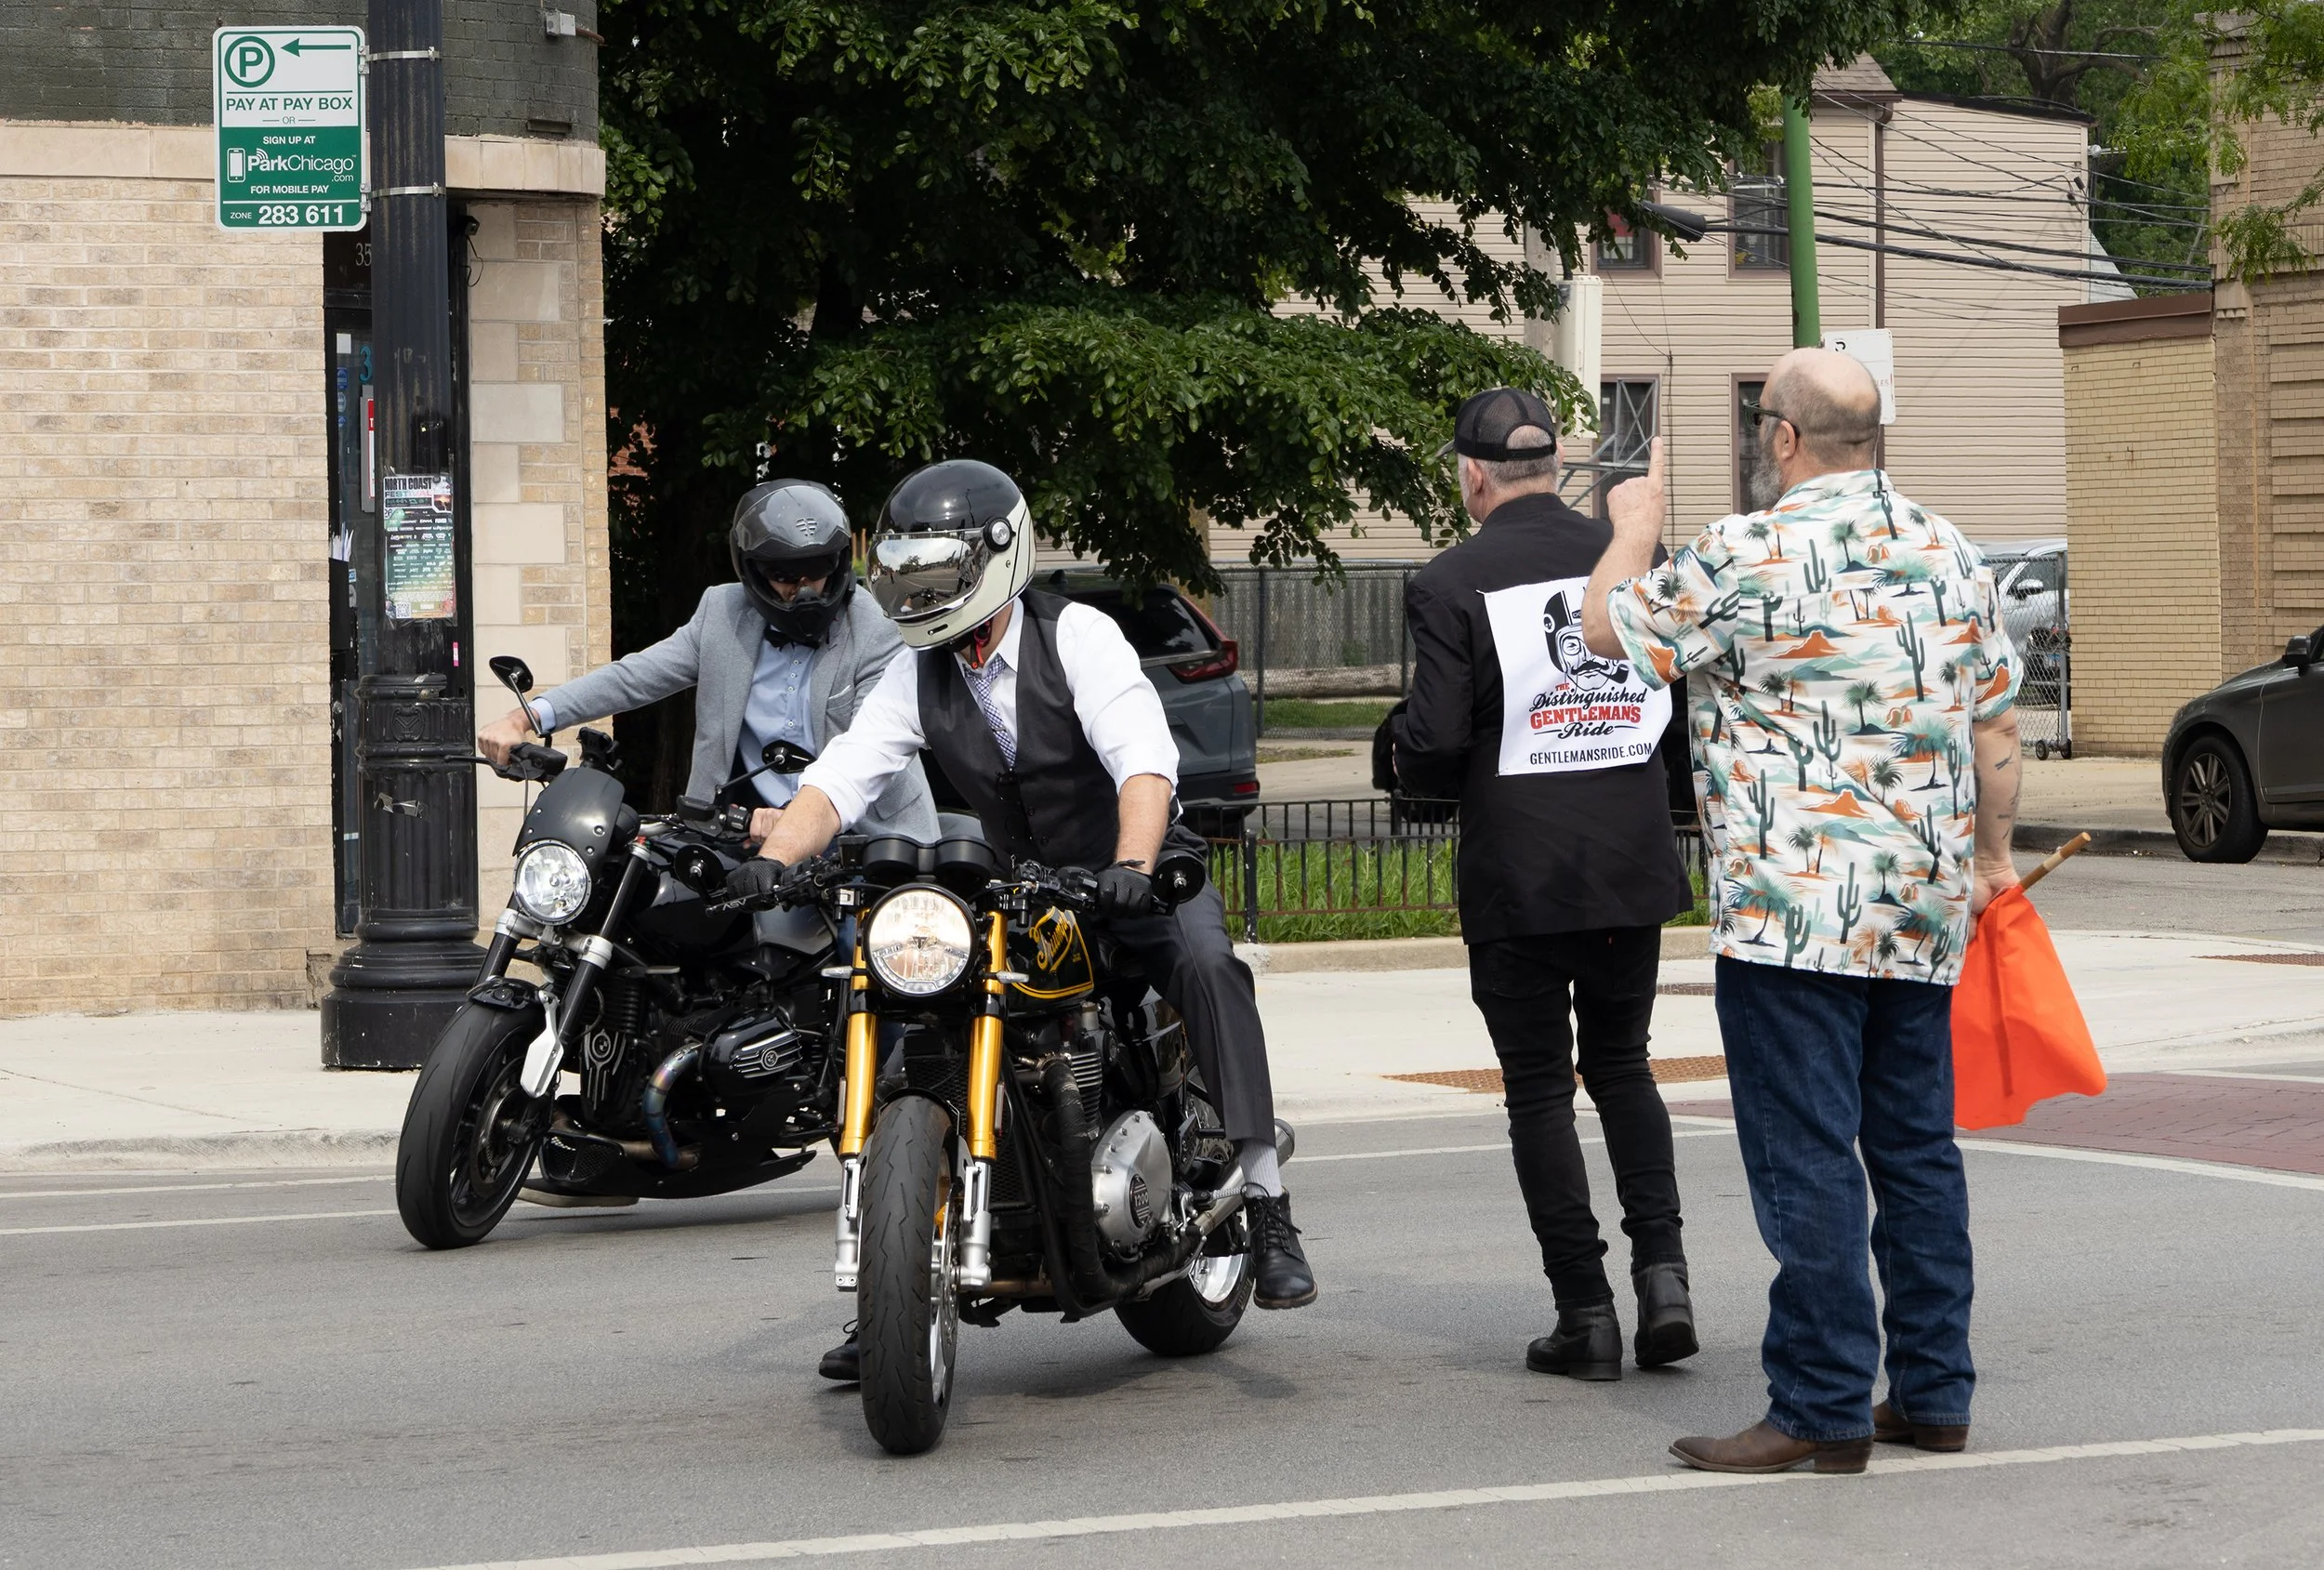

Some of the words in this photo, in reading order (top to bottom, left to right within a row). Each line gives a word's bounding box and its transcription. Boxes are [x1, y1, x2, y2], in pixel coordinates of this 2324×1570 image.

[238, 46, 263, 77] P
[226, 98, 256, 112] PAY
[258, 98, 279, 111] AT
[283, 98, 313, 111] PAY
[318, 97, 353, 110] BOX
[282, 116, 297, 125] OR
[262, 136, 286, 145] SIGN
[288, 136, 302, 144] UP
[303, 135, 316, 144] AT
[247, 153, 354, 174] ParkChicago
[331, 174, 354, 182] .com
[250, 185, 271, 194] FOR
[272, 185, 310, 194] MOBILE
[311, 184, 329, 193] PAY
[258, 205, 299, 225] 283
[305, 204, 344, 224] 611
[385, 477, 407, 491] NORTH
[408, 477, 432, 490] COAST
[1554, 683, 1570, 692] THE
[1529, 686, 1648, 712] Distinguished
[1558, 722, 1616, 740] Ride
[1529, 742, 1653, 765] GENTLEMANSRIDE.COM
[1133, 1191, 1149, 1207] 1200
